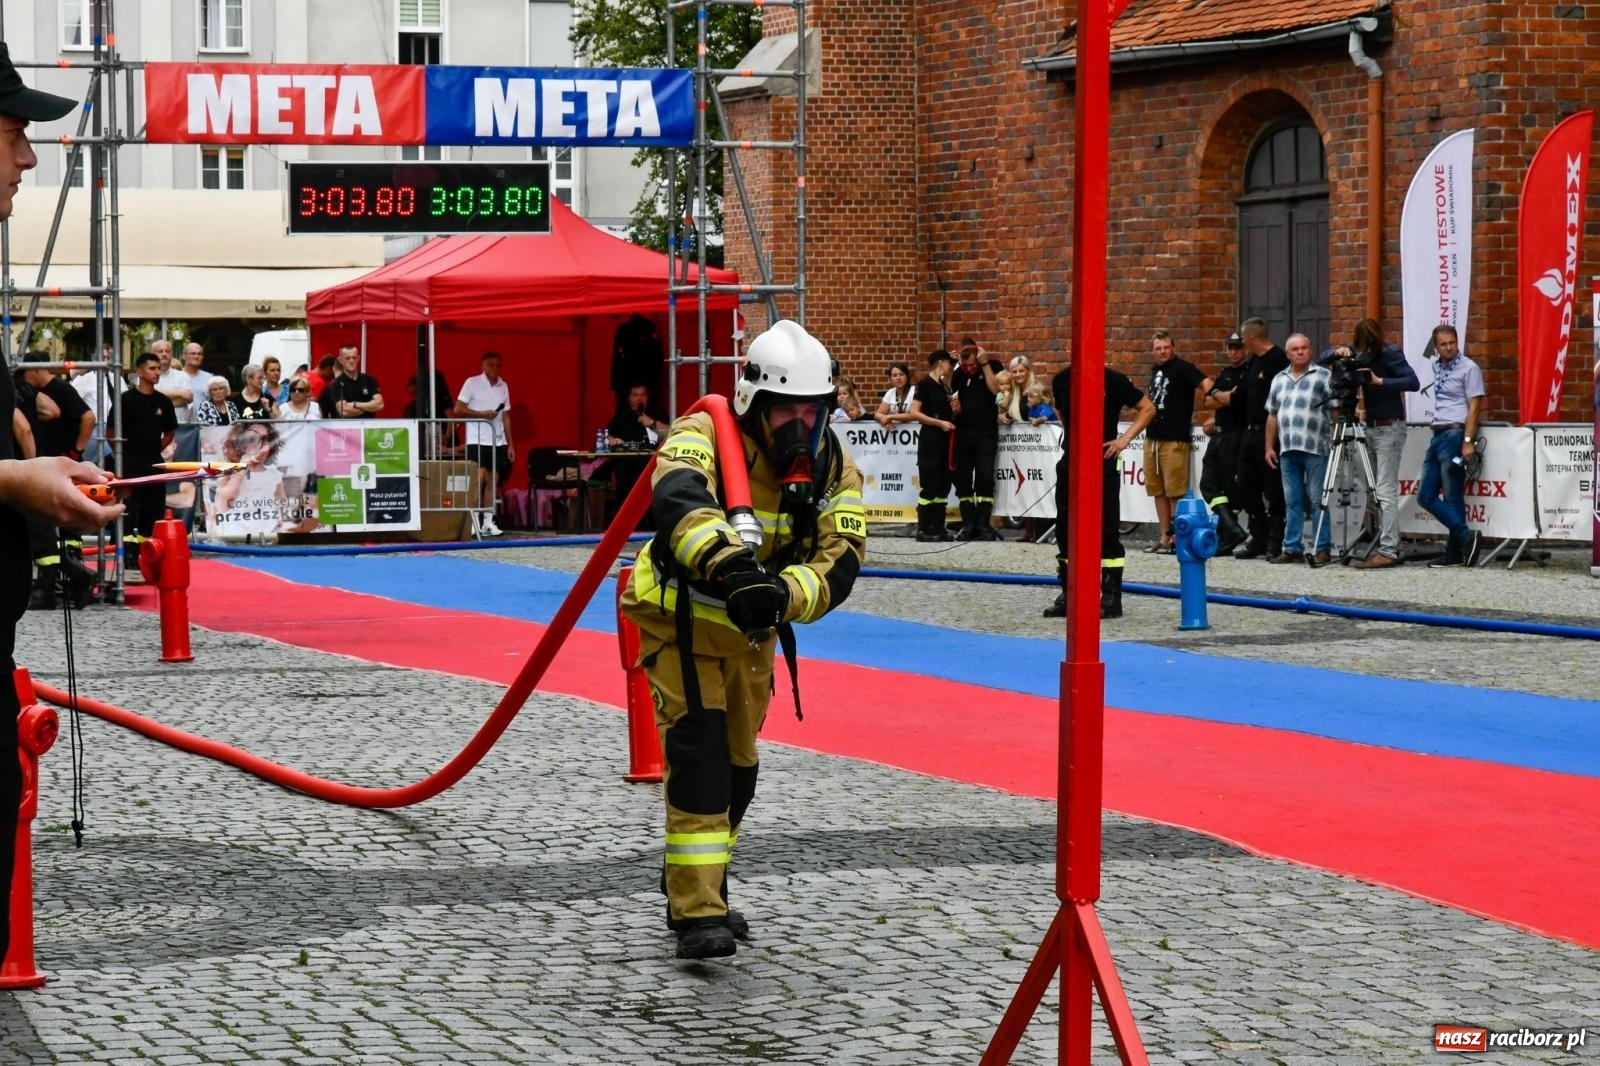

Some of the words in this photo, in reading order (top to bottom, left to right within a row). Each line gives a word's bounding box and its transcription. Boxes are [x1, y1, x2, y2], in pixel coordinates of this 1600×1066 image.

[186, 73, 383, 136] META
[473, 77, 662, 138] META
[300, 186, 416, 217] 3:03.80
[430, 186, 543, 216] 3:03.80
[1434, 165, 1448, 250] TESTOWE
[1438, 255, 1450, 327] ENTRUM
[1547, 152, 1582, 417] KADIMEX
[680, 448, 708, 462] OSP
[996, 468, 1016, 481] ELTA
[1027, 469, 1043, 481] FIRE
[215, 506, 313, 526] przedszkole
[252, 496, 290, 509] więcej
[840, 516, 862, 531] OSP
